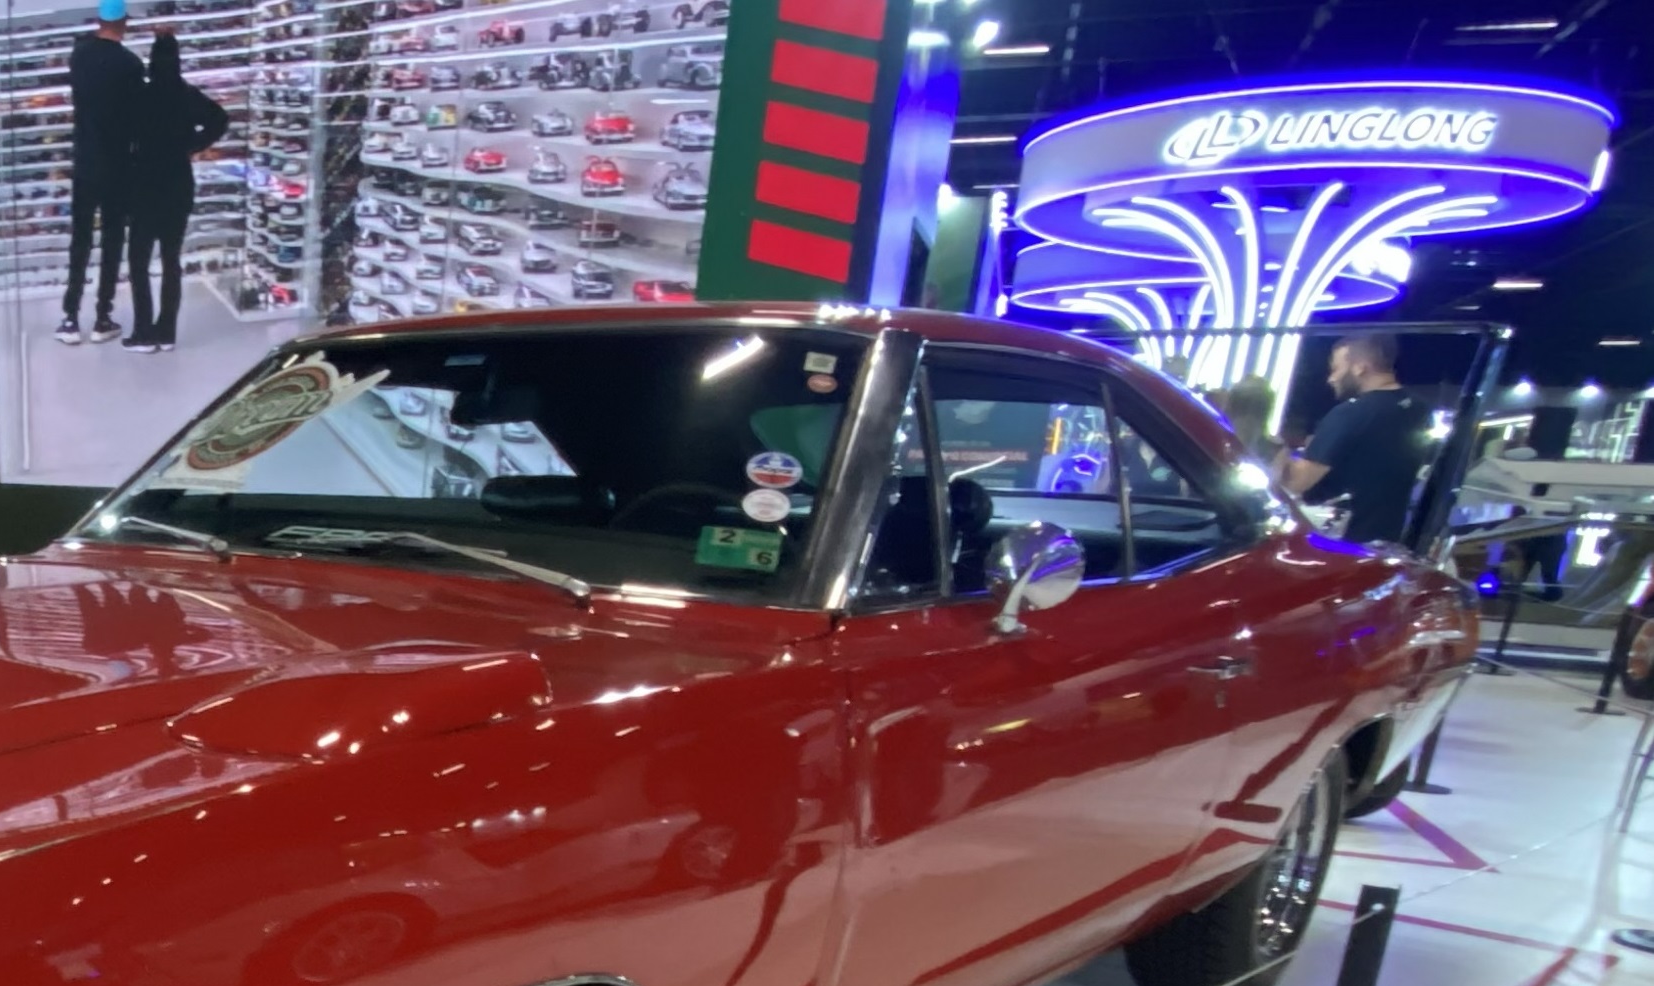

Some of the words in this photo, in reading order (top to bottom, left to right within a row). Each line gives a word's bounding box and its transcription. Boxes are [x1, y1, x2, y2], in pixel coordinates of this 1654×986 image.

[1268, 111, 1497, 147] LINGLONG
[718, 529, 736, 544] 2
[756, 552, 773, 566] 6
